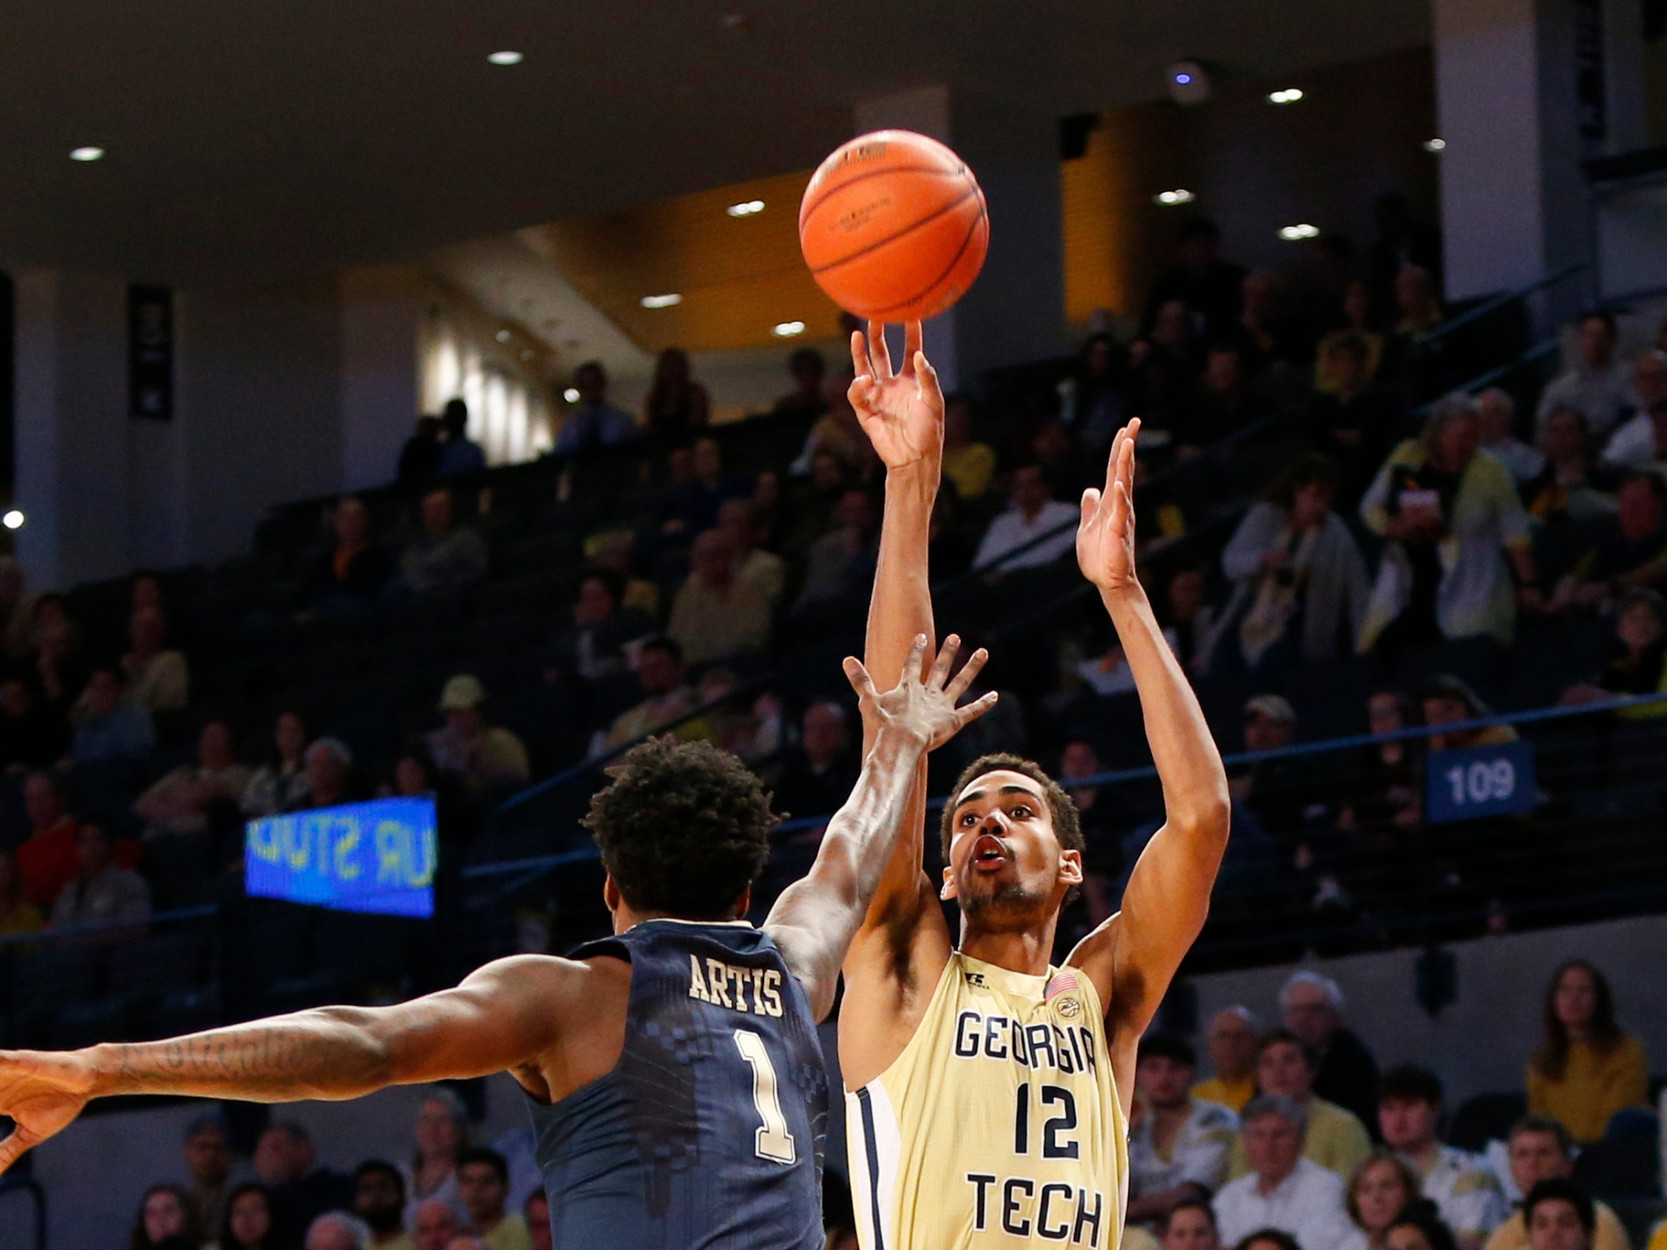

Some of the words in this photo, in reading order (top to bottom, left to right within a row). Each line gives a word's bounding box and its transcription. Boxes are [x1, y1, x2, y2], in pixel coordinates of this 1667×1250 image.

[1446, 759, 1515, 805] 109
[689, 953, 783, 1018] ARTIS
[733, 1028, 796, 1165] 1
[1013, 1081, 1081, 1162] 12
[965, 1171, 1103, 1250] TECH
